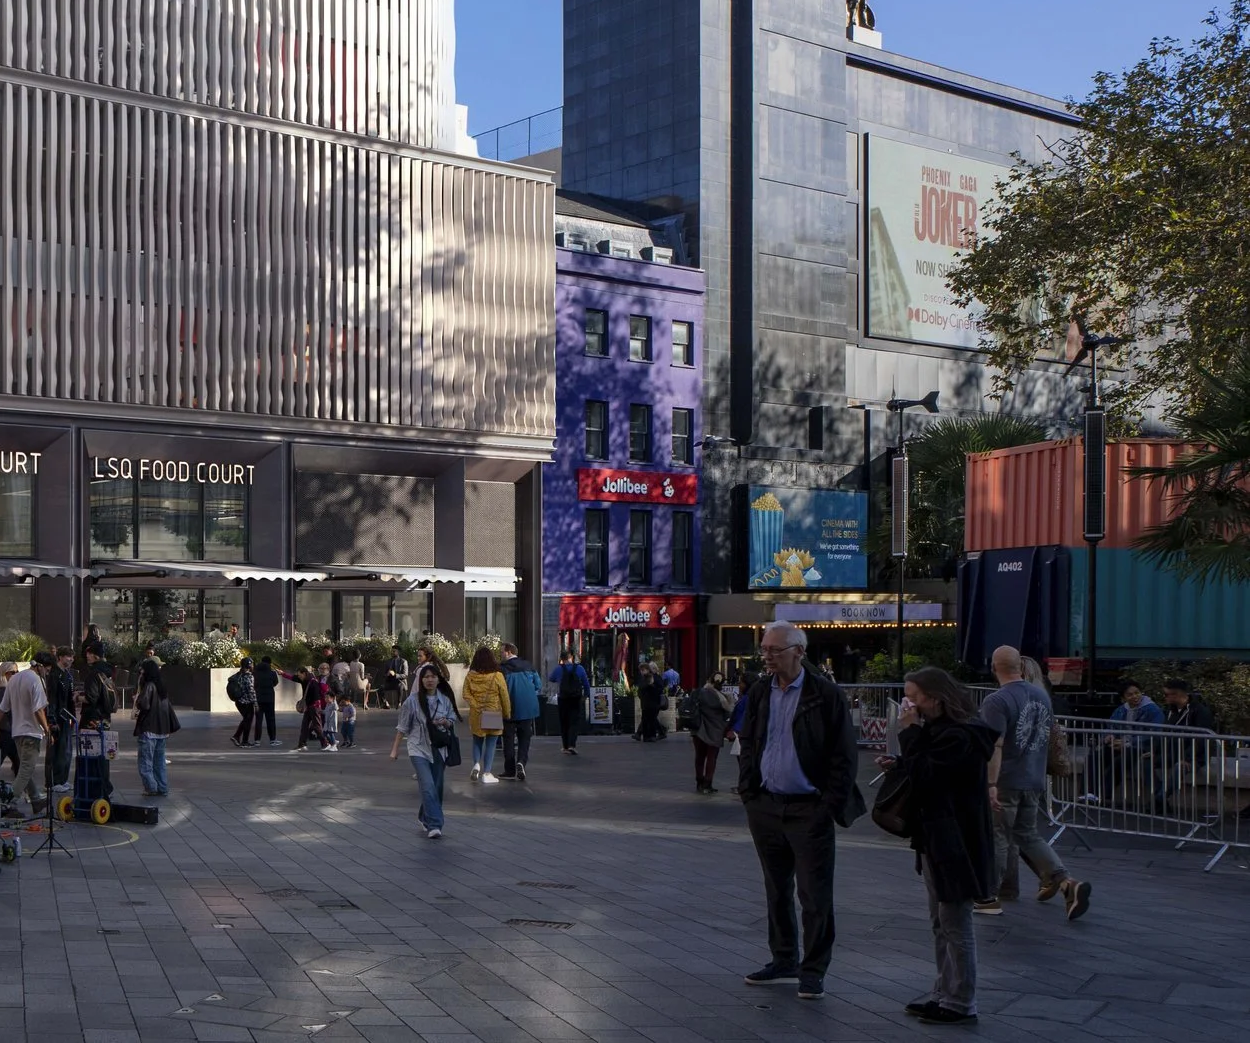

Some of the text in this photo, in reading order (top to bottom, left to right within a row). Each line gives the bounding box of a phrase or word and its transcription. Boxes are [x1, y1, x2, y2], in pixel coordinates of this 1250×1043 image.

[921, 165, 978, 192] PHOENIX GAGA
[914, 184, 978, 250] JOKER
[916, 259, 936, 278] NOW
[921, 308, 948, 330] Dolby
[94, 456, 255, 485] LSQ FOOD COURT
[602, 477, 648, 495] Jollibee
[821, 519, 859, 528] CINEMA WITH
[843, 530, 859, 539] SIDES
[997, 561, 1023, 573] AQ402
[604, 605, 651, 623] Jollibee
[841, 607, 886, 618] BOOK NOW
